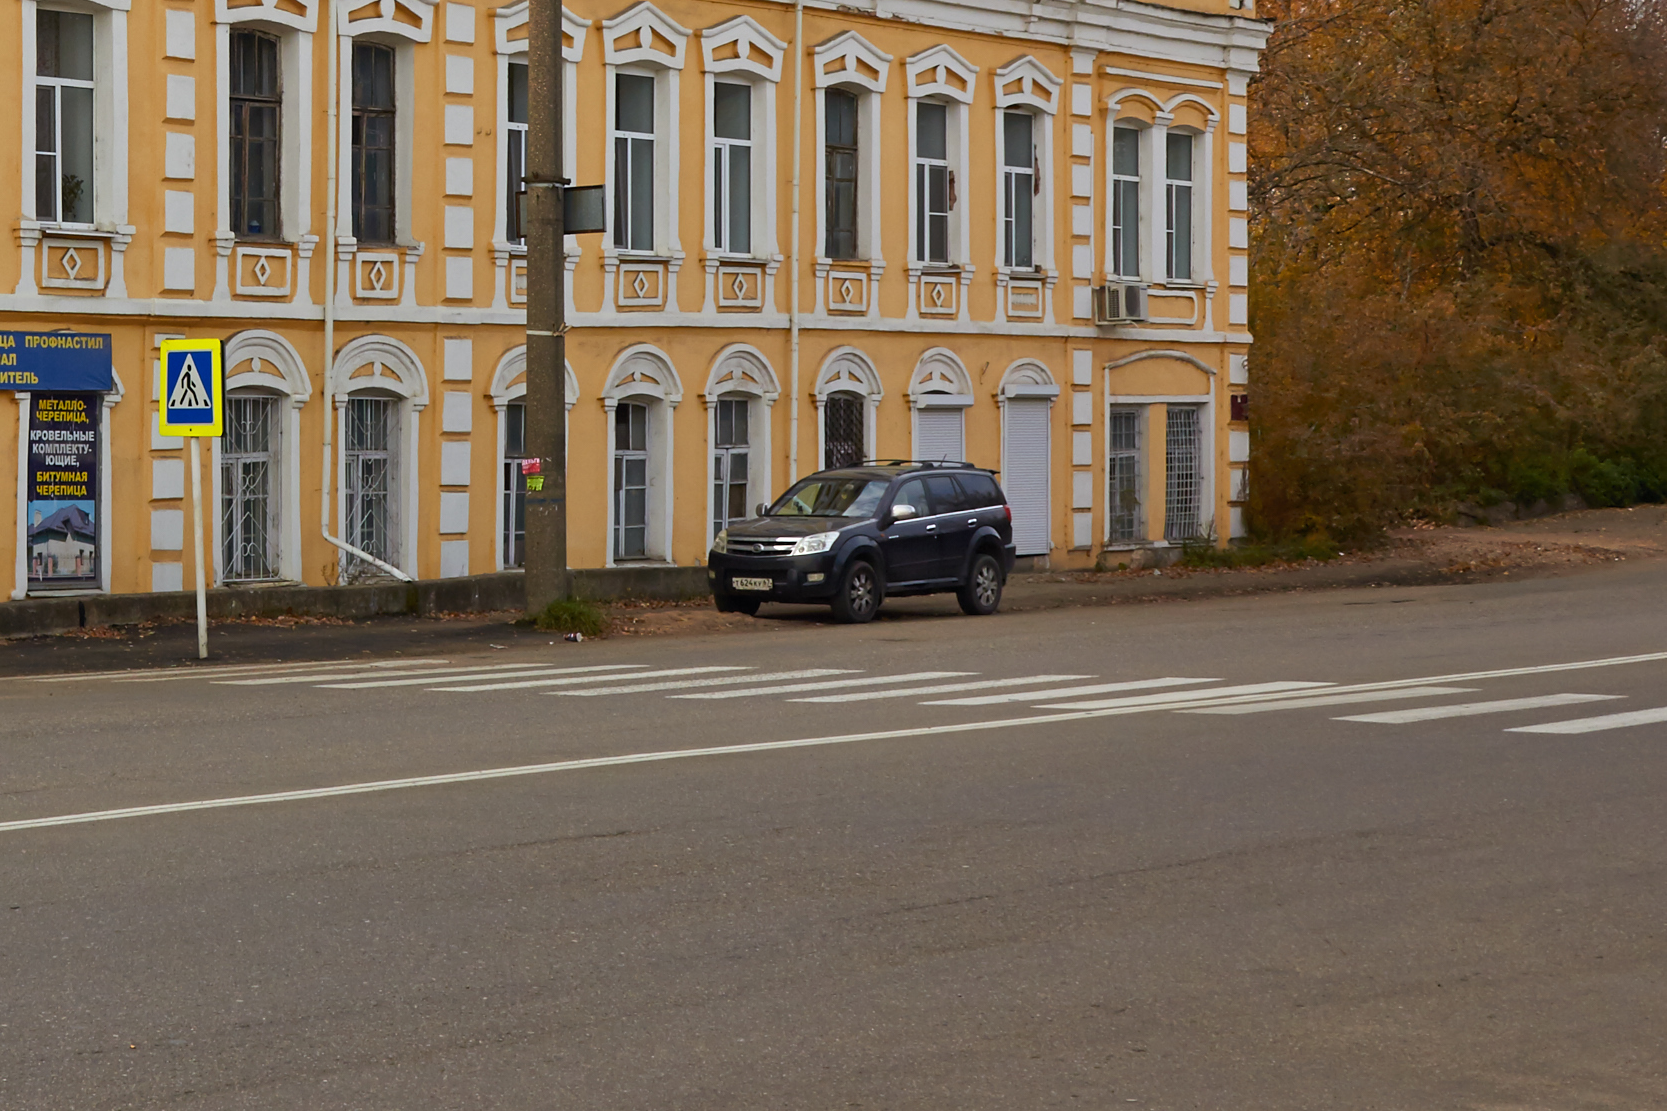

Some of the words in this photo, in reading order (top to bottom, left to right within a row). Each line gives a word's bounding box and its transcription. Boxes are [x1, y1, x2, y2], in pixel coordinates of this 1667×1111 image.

[25, 336, 104, 349] ПРОФНАСТИЛ
[38, 399, 87, 411] МЕТАЛЛО-
[36, 411, 89, 424] ЧЕРЕПИЦА,
[30, 430, 95, 441] КРОВЕЛЬНЫЕ
[32, 443, 92, 455] КОМПЛЕКТУ-
[45, 455, 80, 467] ЮЩИЕ,
[36, 471, 88, 482] БИТУМНАЯ
[36, 485, 87, 497] ЧЕРЕПИЦА
